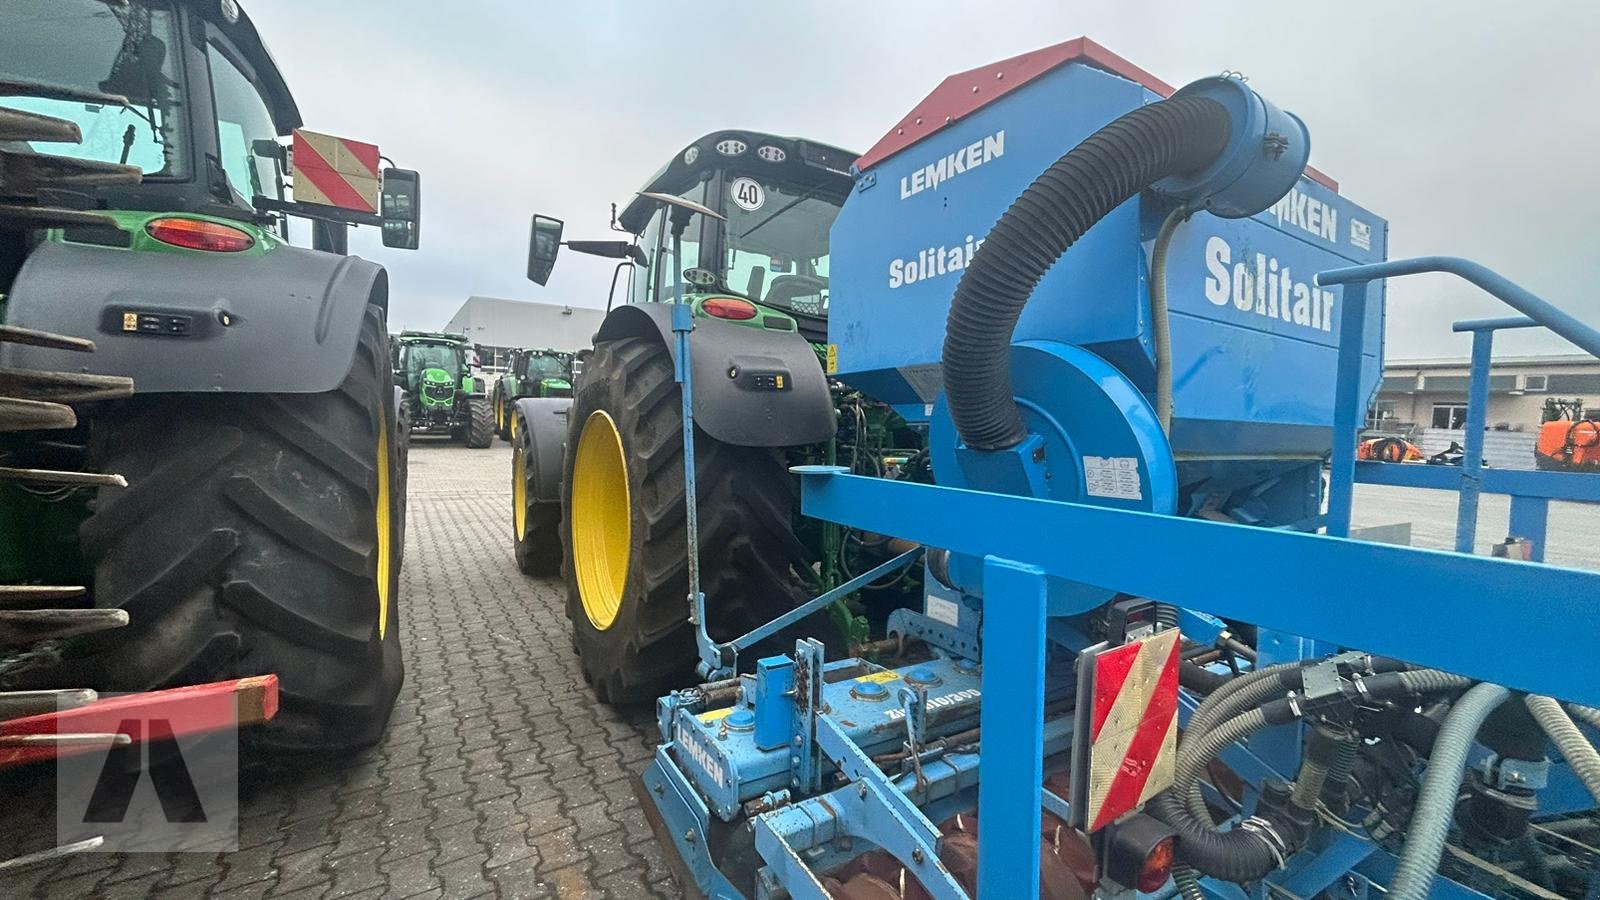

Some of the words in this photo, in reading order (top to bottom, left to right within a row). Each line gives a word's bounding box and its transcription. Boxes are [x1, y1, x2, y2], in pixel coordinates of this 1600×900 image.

[738, 183, 758, 205] 40
[900, 130, 1005, 200] LEMKEN
[1265, 187, 1337, 243] MKEN
[1205, 236, 1334, 332] Solitair
[677, 724, 723, 789] LEMKEN
